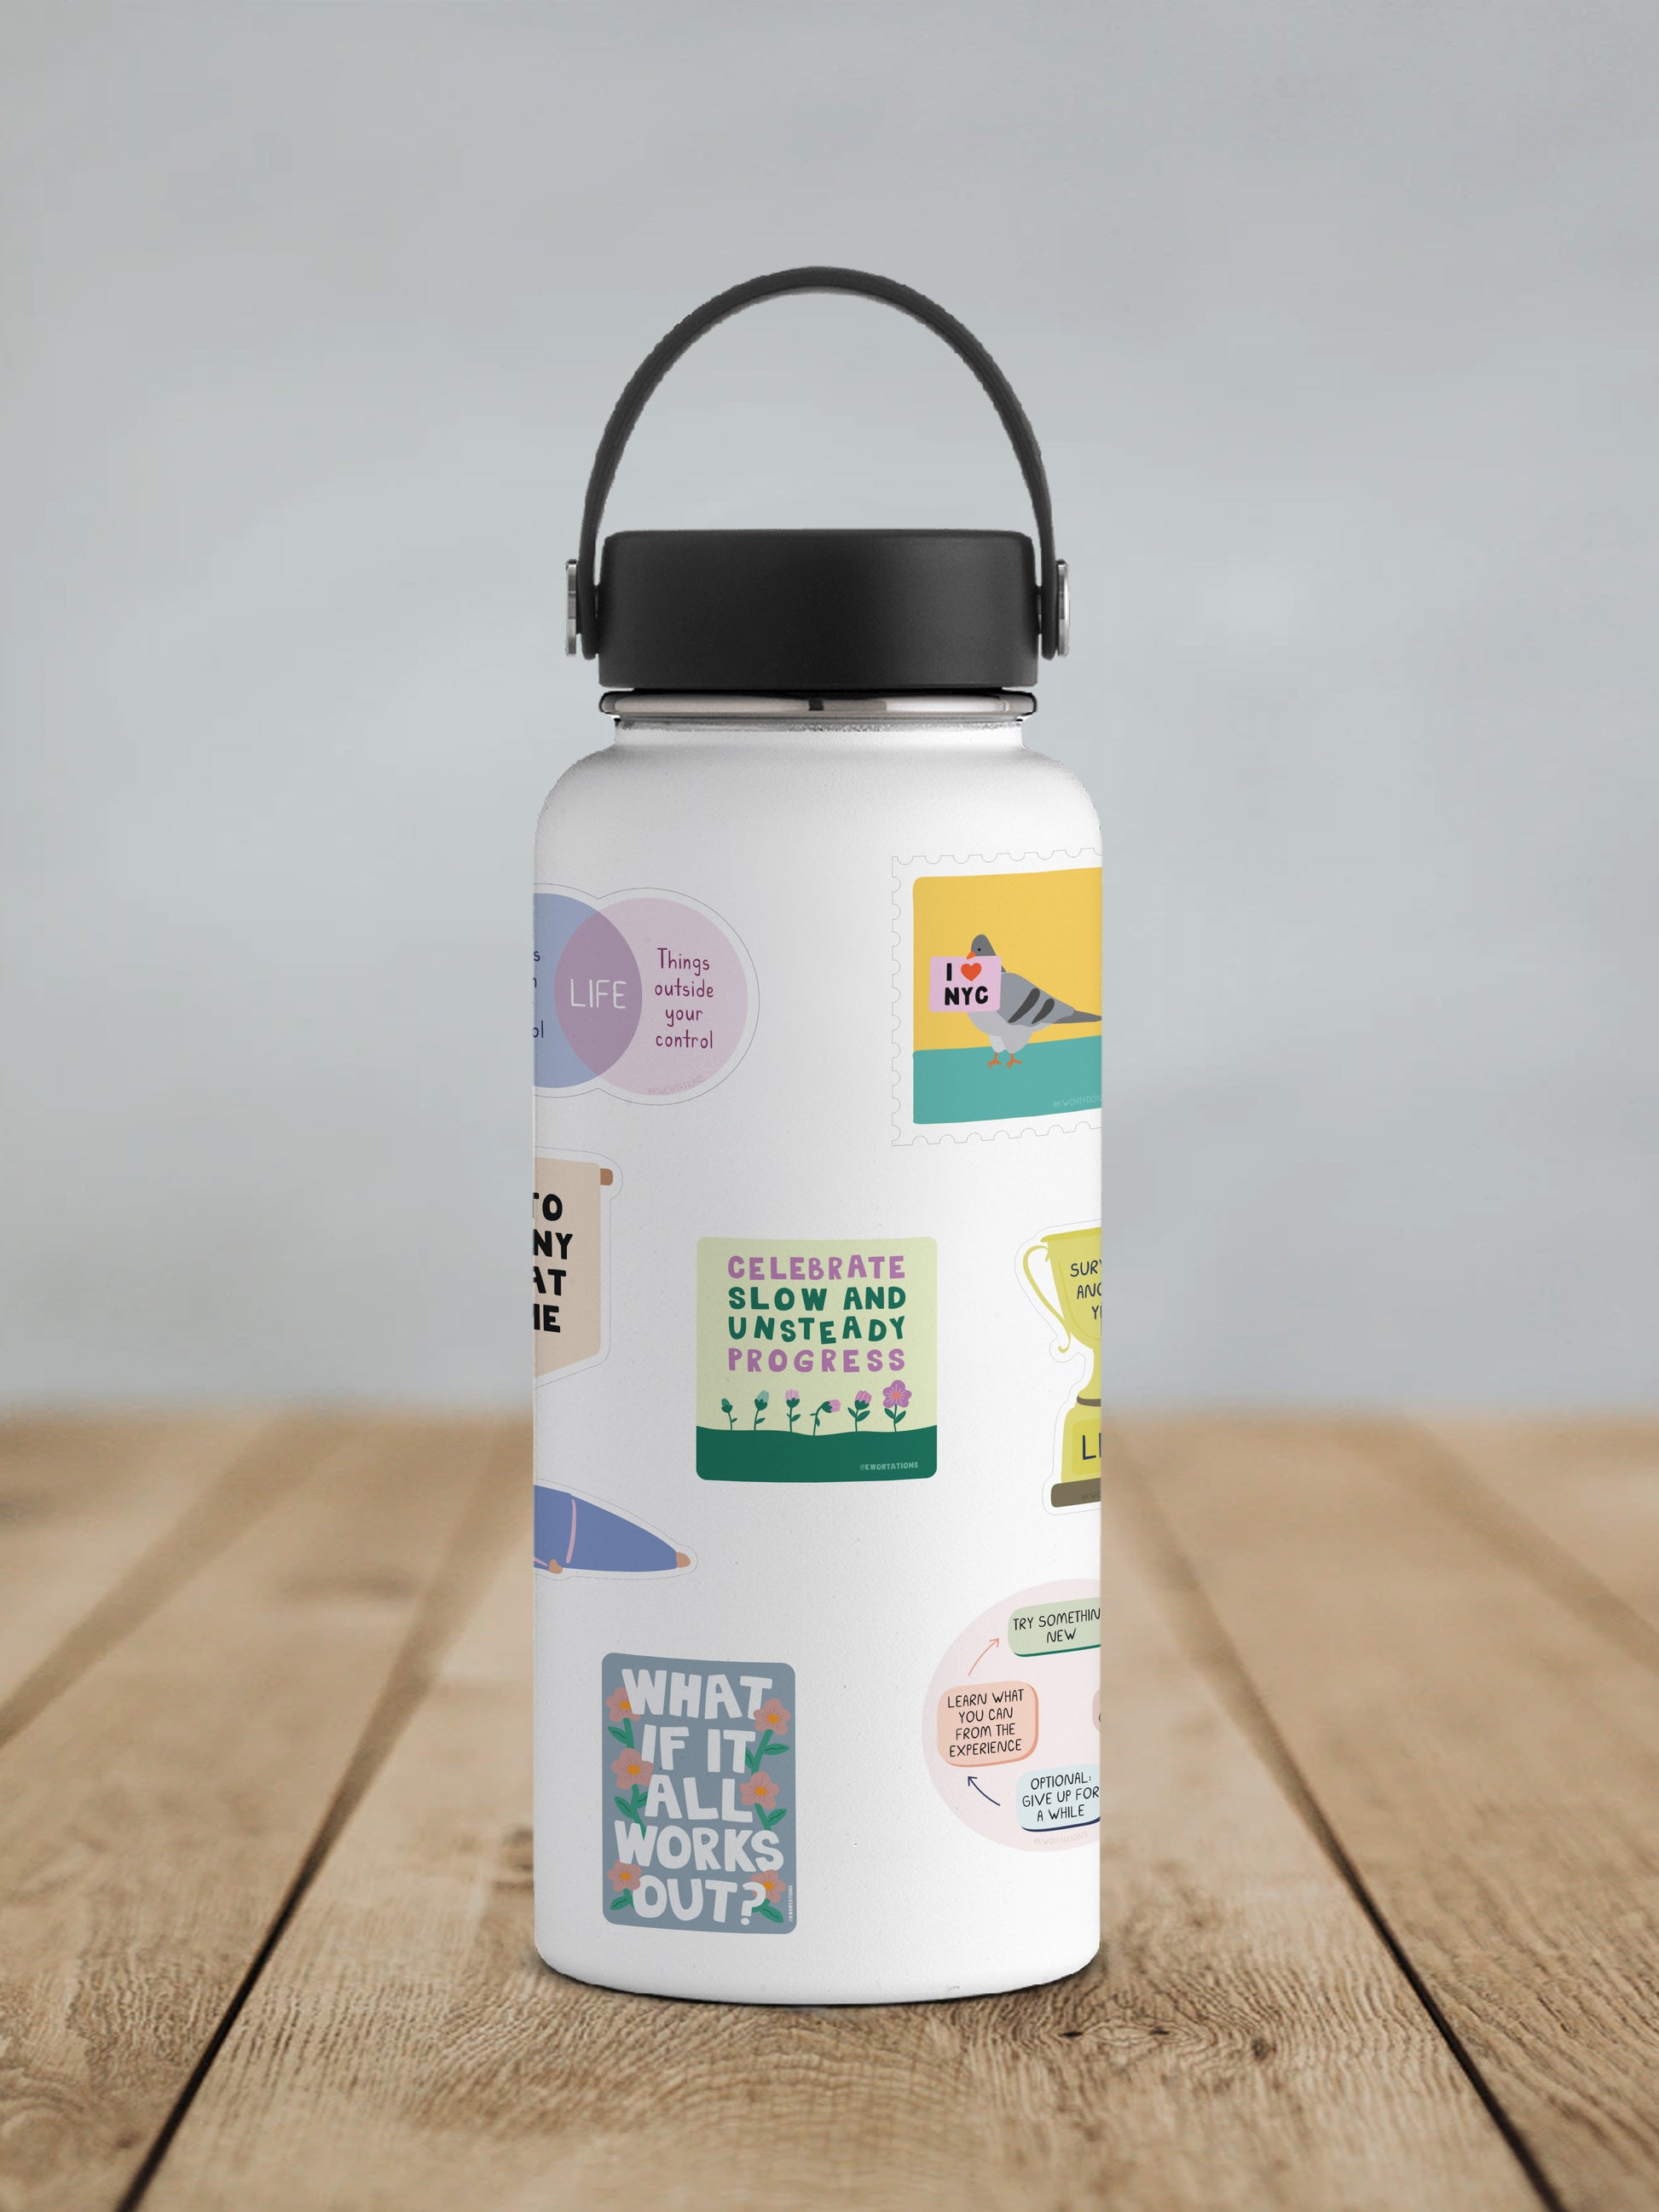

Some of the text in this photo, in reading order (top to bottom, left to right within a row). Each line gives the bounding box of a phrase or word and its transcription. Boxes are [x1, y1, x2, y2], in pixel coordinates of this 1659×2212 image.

[656, 947, 710, 976] Things
[945, 963, 953, 982] I
[570, 978, 627, 1009] LIFE
[655, 977, 714, 998] outside
[944, 986, 989, 1005] NYC
[665, 1008, 703, 1028] your
[656, 1029, 713, 1049] control
[727, 1254, 906, 1281] CELEBRATE
[1070, 1259, 1101, 1277] SUR
[728, 1286, 906, 1312] SLOW AND
[728, 1315, 906, 1345] UNSTEADY
[728, 1347, 905, 1373] PROGRESS
[1013, 1607, 1101, 1630] TRY SOMETHIN
[1046, 1628, 1077, 1643] NEW
[621, 1668, 773, 1720] WHAT
[947, 1688, 1025, 1709] LEARN WHAT
[958, 1707, 1014, 1724] YOU CAN
[956, 1723, 1015, 1740] FROM THE
[640, 1723, 756, 1775] IF IT
[949, 1738, 1022, 1757] EXPERIENCE
[1031, 1773, 1092, 1790] OPTIONAL:
[644, 1774, 754, 1823] ALL
[1022, 1786, 1100, 1808] GIVE UP FOR
[1037, 1804, 1085, 1822] A WHILE
[614, 1820, 784, 1873] WORKS
[632, 1874, 766, 1926] OUT?
